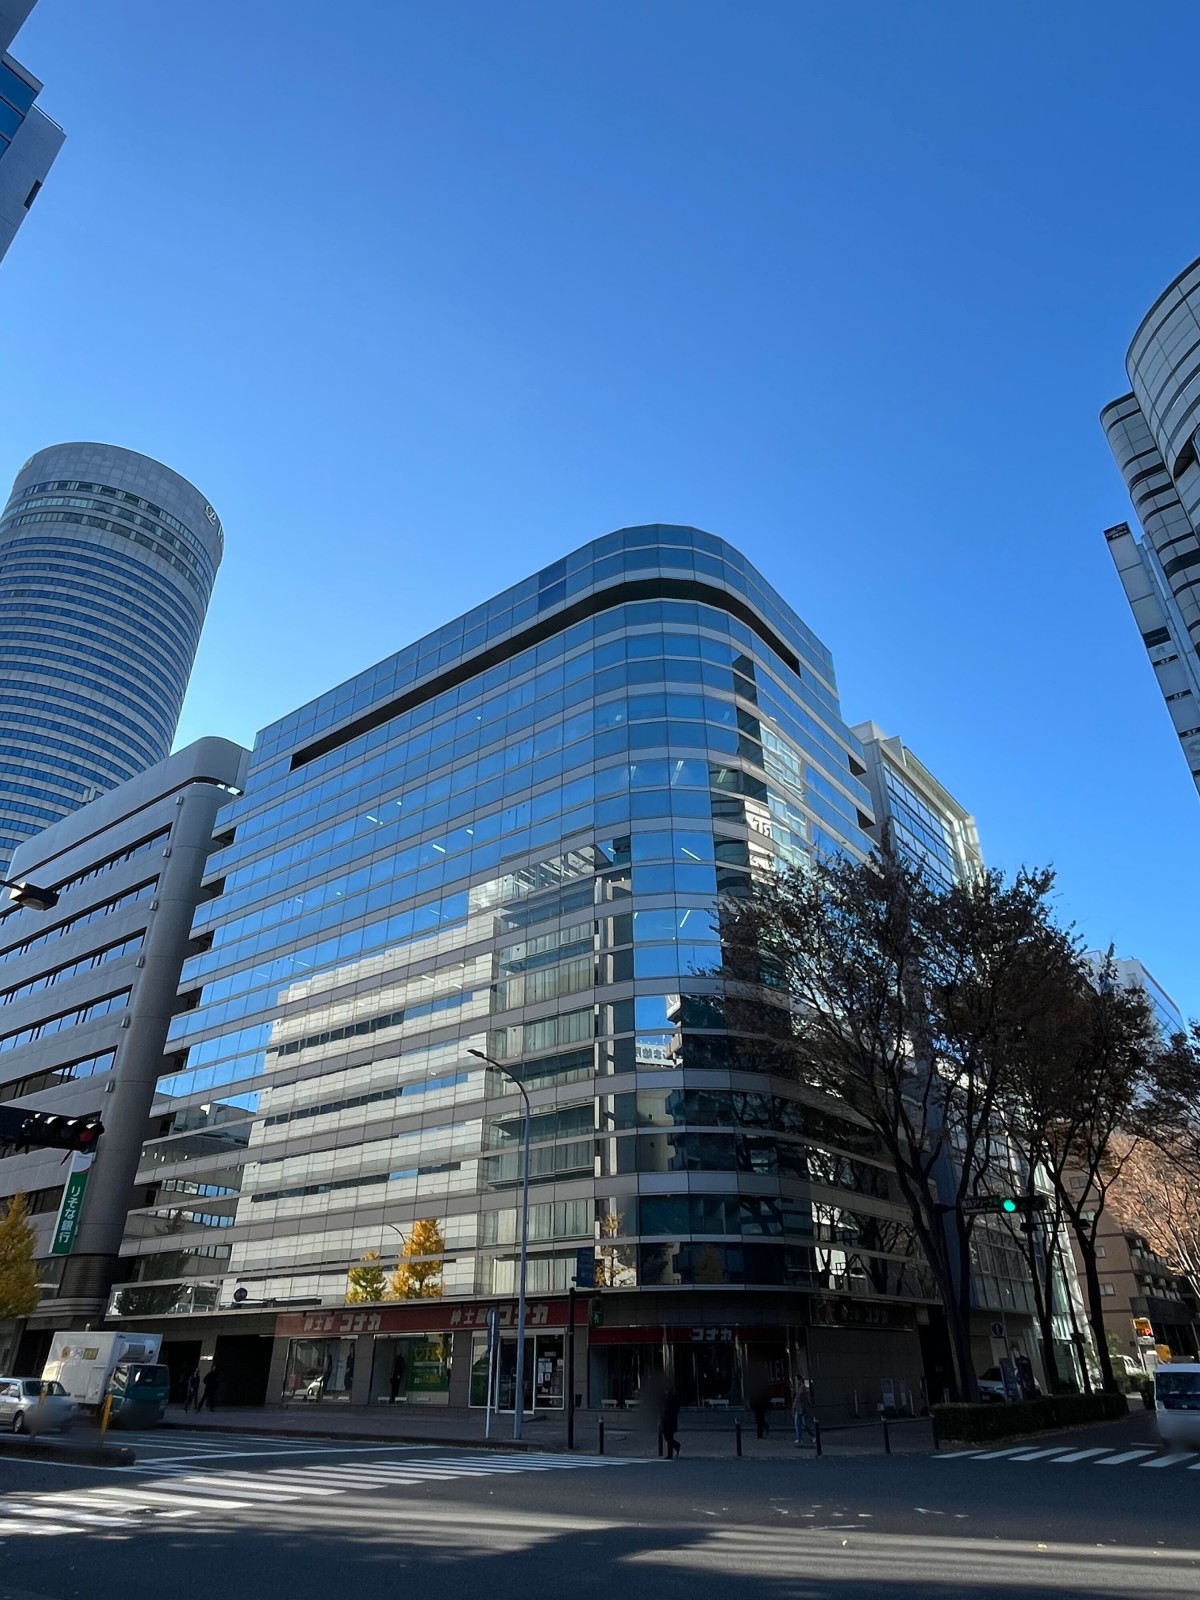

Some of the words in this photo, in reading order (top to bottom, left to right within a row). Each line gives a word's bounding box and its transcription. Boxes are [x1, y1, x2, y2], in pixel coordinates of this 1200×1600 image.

[58, 1185, 81, 1244] りそな銀行
[339, 1312, 382, 1332] コナカ
[691, 1327, 733, 1341] コナカ
